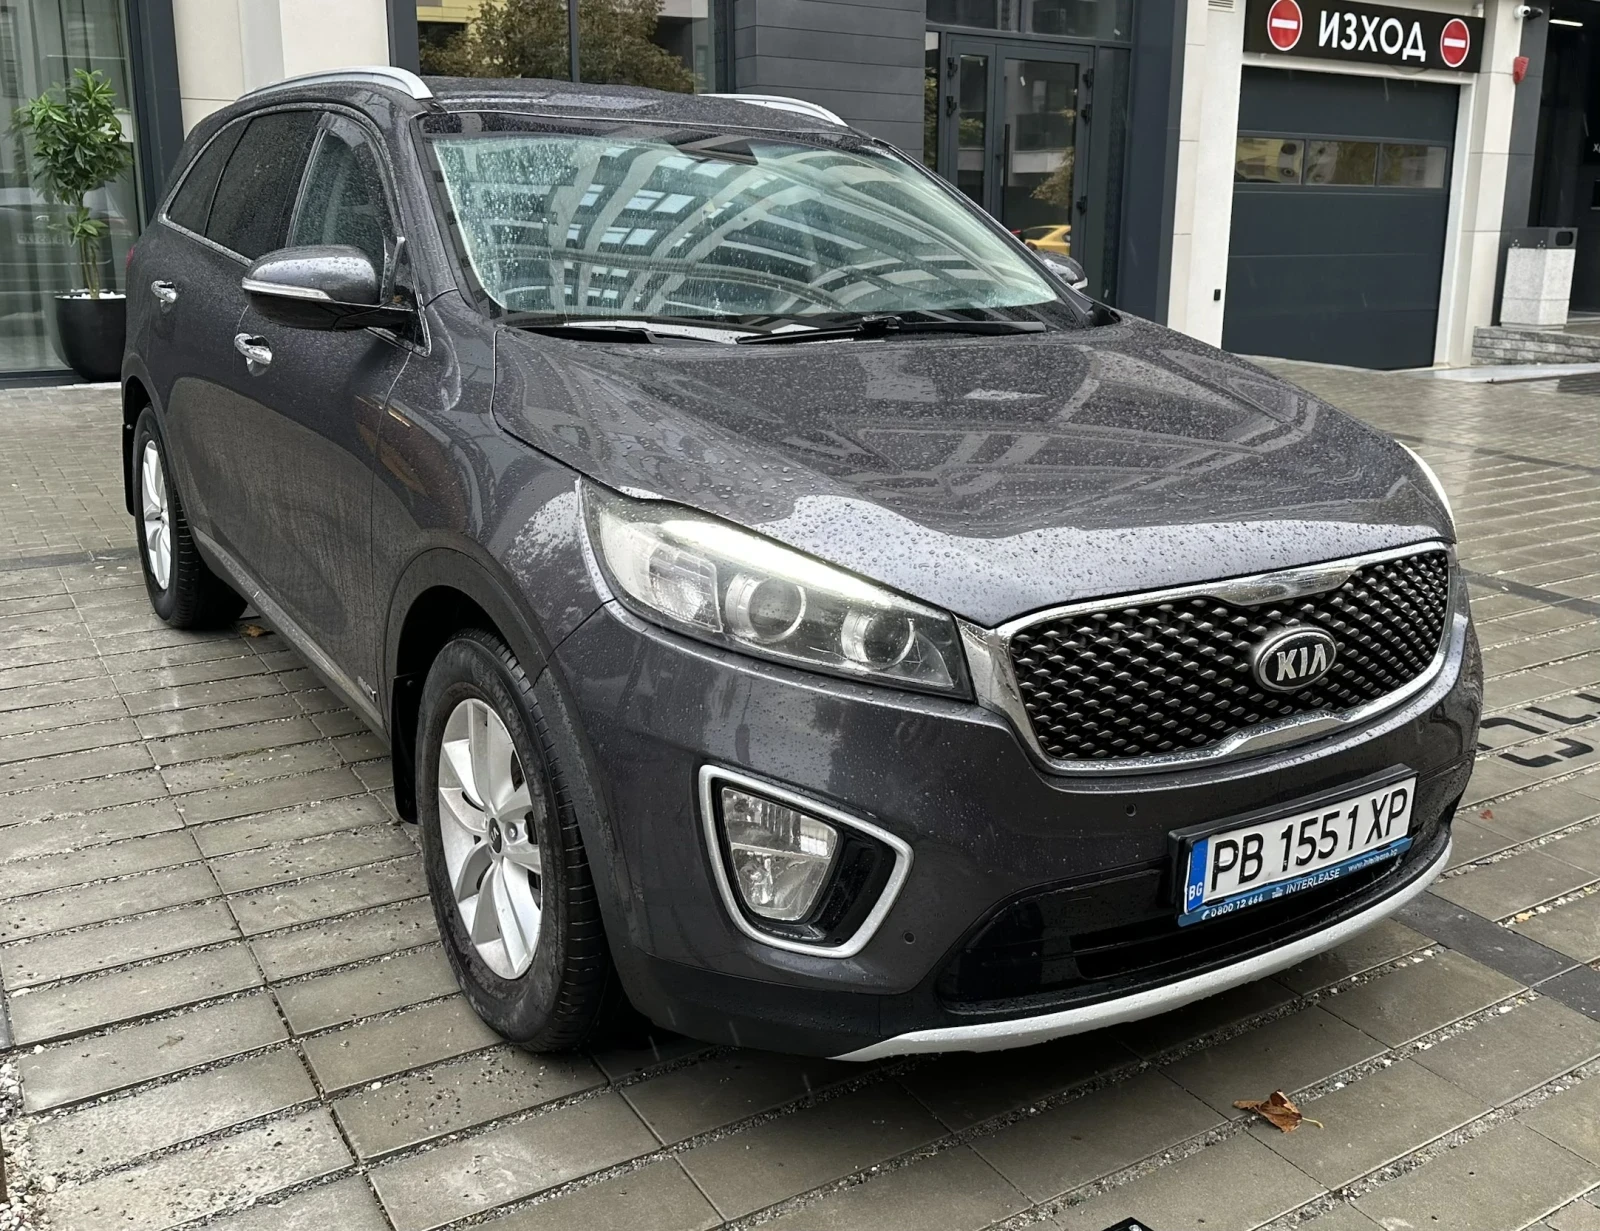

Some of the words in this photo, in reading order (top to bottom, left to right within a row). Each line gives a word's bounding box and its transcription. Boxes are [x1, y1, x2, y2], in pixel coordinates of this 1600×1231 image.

[1317, 10, 1427, 63] ИЗХОД
[1276, 643, 1327, 681] KIA
[1210, 832, 1264, 893] PB
[1280, 804, 1360, 873] 1551
[1364, 787, 1408, 846] XP
[1188, 881, 1203, 901] BG
[1210, 902, 1234, 918] 0800
[1236, 899, 1247, 912] 12
[1285, 868, 1341, 895] INTERLEASE
